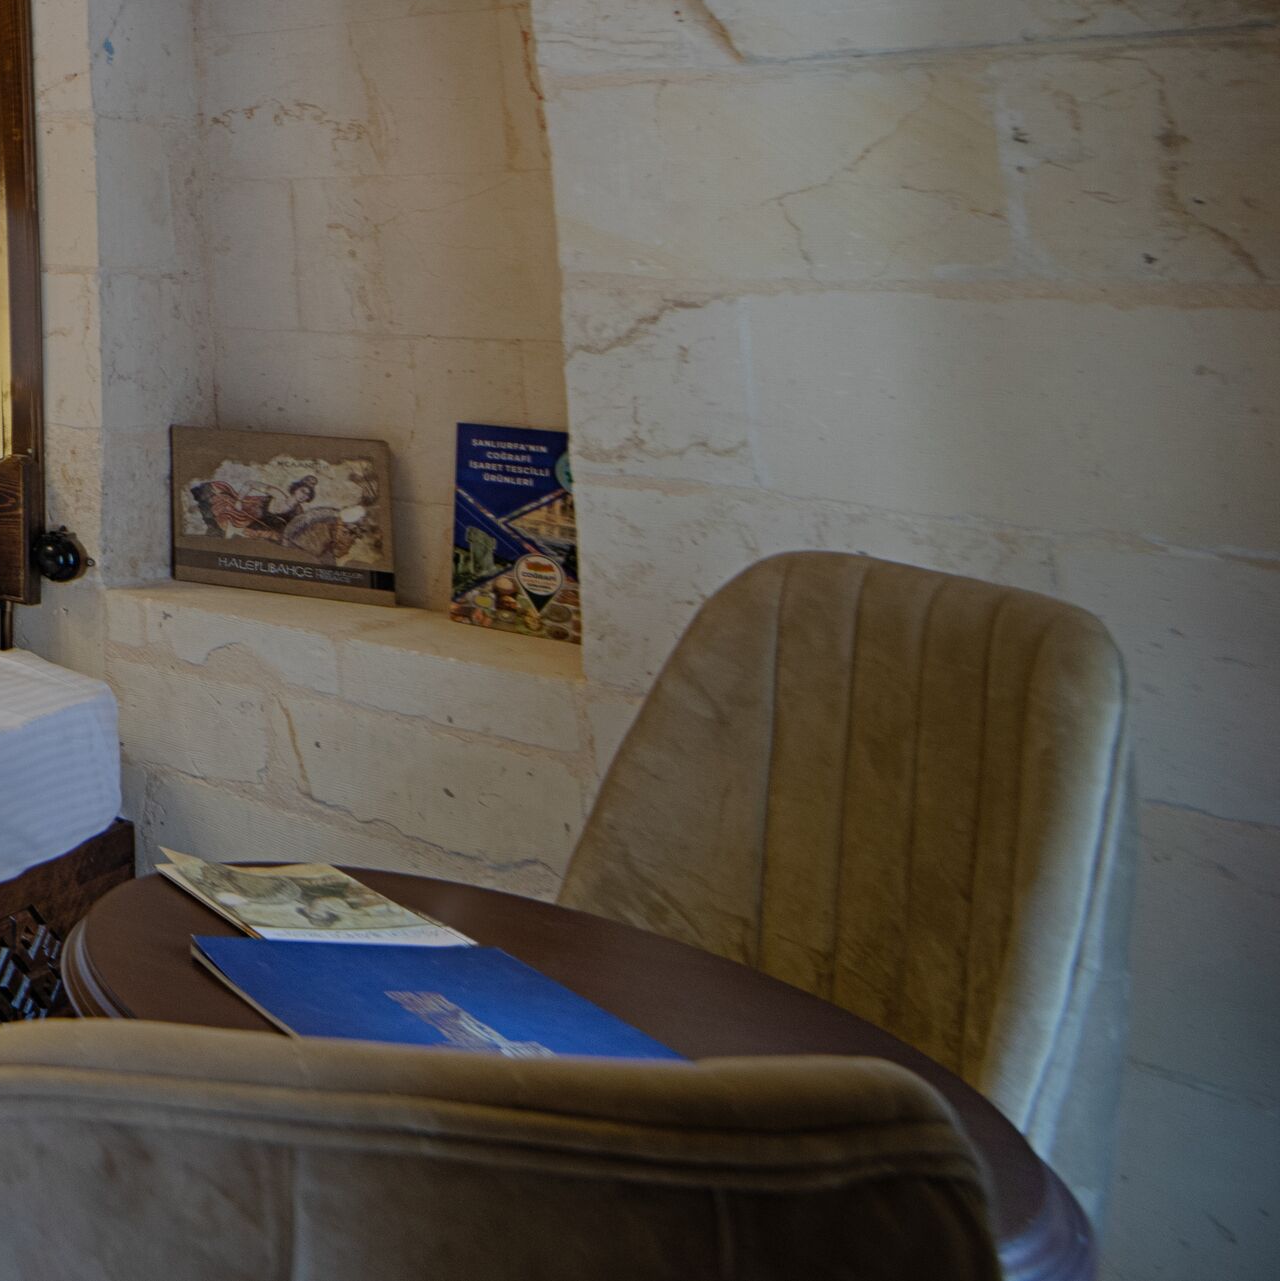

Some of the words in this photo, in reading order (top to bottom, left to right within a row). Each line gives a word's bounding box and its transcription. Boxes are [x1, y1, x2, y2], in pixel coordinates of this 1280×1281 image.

[471, 439, 548, 453] ŞANLIURFA'NIN
[485, 451, 532, 463] COĞRAFİ
[482, 472, 534, 486] ÜRÜNLERİ
